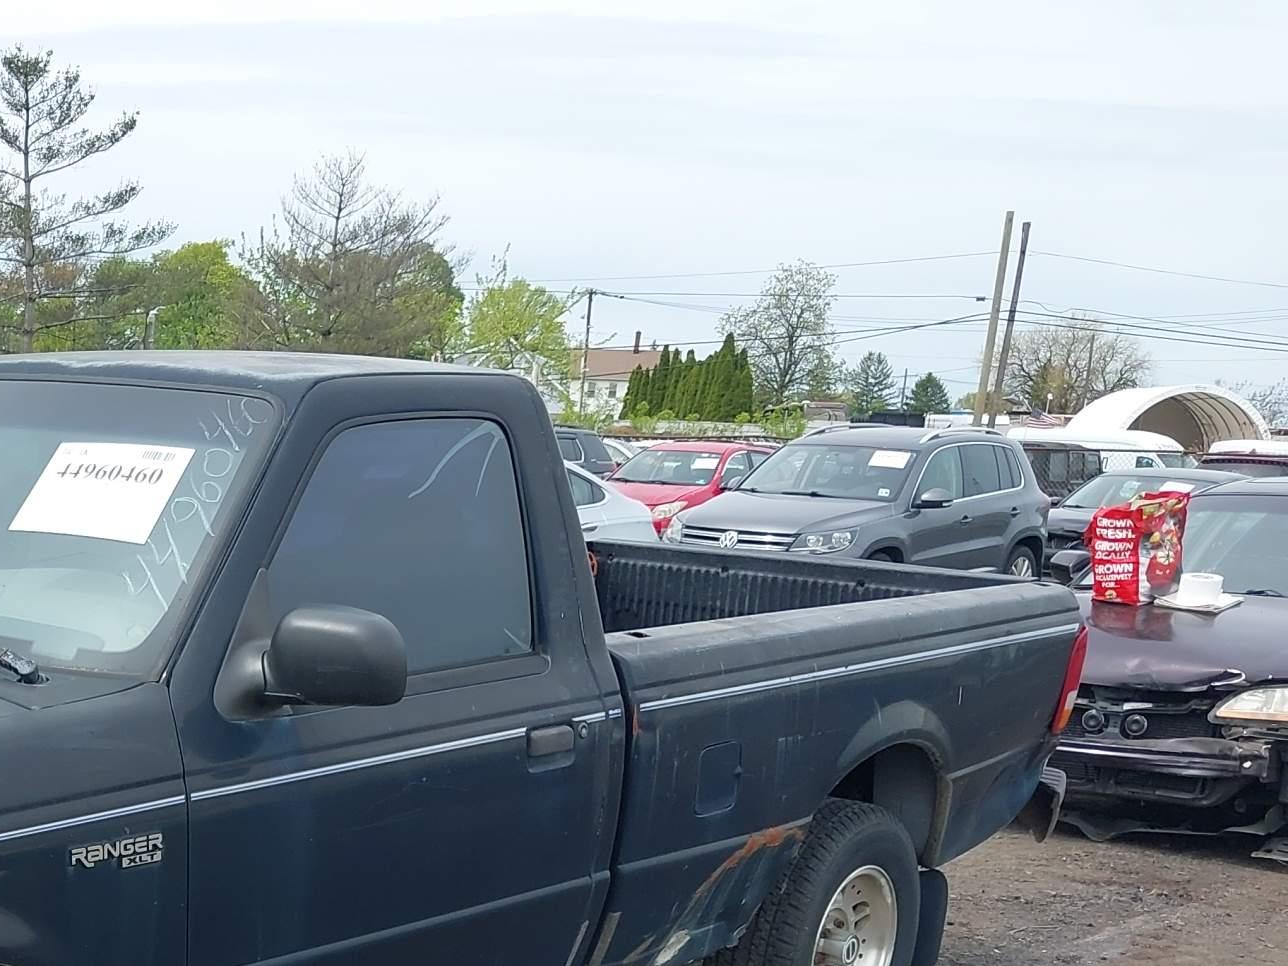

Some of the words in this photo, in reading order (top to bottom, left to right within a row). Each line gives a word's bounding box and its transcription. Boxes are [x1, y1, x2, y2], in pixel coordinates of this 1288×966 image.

[56, 463, 164, 485] 44960460
[1095, 528, 1136, 539] FRESH.
[1094, 541, 1134, 551] GROWN
[1094, 551, 1132, 560] OCALLY.
[71, 833, 164, 868] RANGER
[126, 852, 158, 866] XLT
